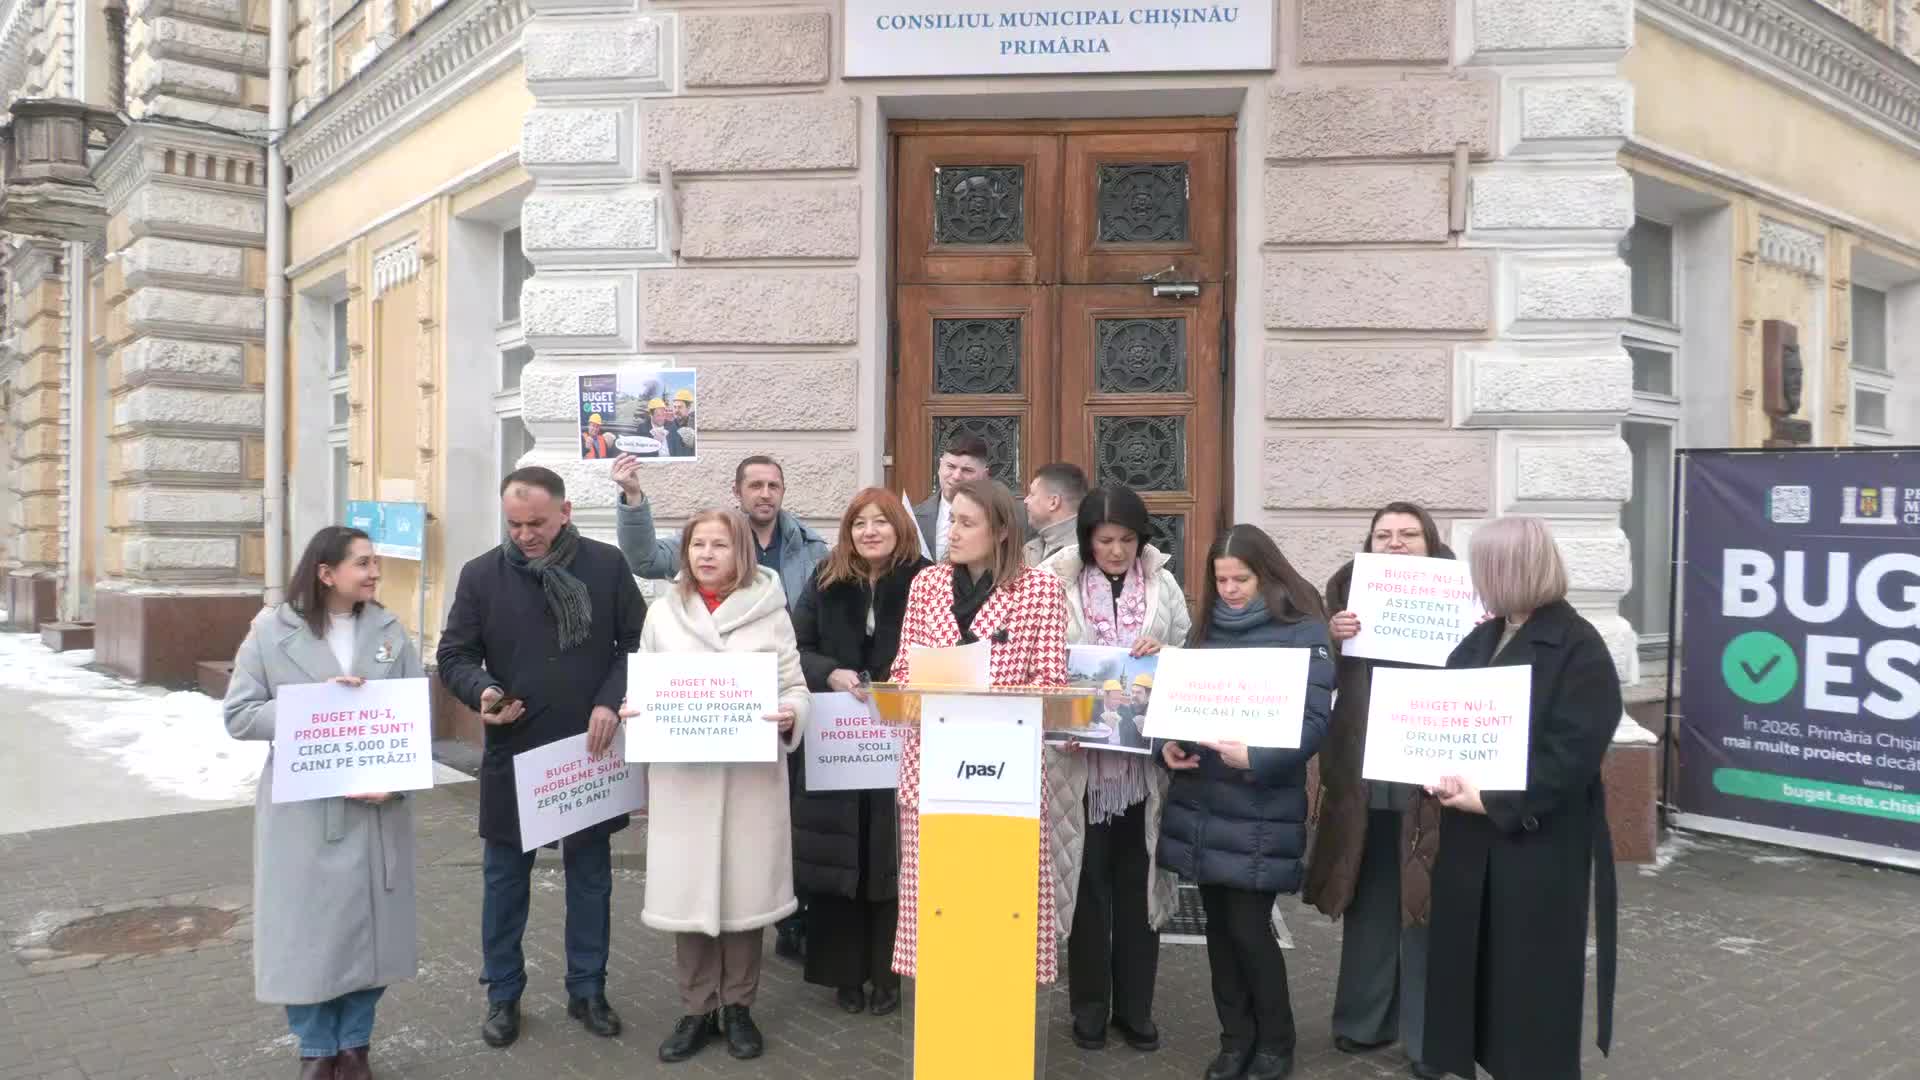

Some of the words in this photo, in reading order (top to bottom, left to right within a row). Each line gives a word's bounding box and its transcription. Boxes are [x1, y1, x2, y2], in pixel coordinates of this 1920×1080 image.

[876, 13, 994, 30] CONSILIUL
[999, 9, 1124, 28] MUNICIPAL
[1128, 7, 1239, 31] CHIȘINĂU
[1000, 37, 1111, 55] PRIMĂRIA
[582, 392, 613, 402] BUGET
[591, 402, 614, 412] ESTE
[1385, 569, 1426, 581] BUGET
[1368, 582, 1437, 596] PROBLEME
[1722, 548, 1920, 629] BUG
[1382, 612, 1460, 628] PERSONALI
[670, 678, 706, 687] BUGET
[656, 690, 719, 699] PROBLEME
[719, 690, 753, 699] SUNT!
[646, 703, 685, 711] GRUPE
[688, 702, 702, 711] CU
[706, 702, 762, 711] PROGRAM
[1410, 700, 1458, 711] BUGET
[311, 711, 355, 724] BUGET
[359, 708, 396, 721] NU-I,
[655, 714, 720, 723] PRELUNGIT
[723, 713, 753, 723] FĂRĂ
[1475, 715, 1513, 727] SUNT!
[295, 725, 366, 741] PROBLEME
[370, 722, 414, 735] SUNT!
[821, 729, 887, 740] PROBLEME
[1406, 731, 1477, 743] DRUMURI
[1482, 733, 1498, 743] CU
[1743, 715, 1757, 731] În
[1807, 724, 1872, 745] Primăria
[298, 744, 341, 756] CIRCA
[345, 740, 385, 752] 5.000
[390, 738, 409, 749] DE
[1403, 747, 1453, 760] GROPI
[1459, 749, 1499, 760] SUNT!
[1723, 735, 1751, 749] mai
[1754, 740, 1800, 756] multe
[1803, 747, 1873, 765] proiecte
[336, 757, 354, 768] PE
[358, 752, 417, 767] STRĂZI!
[545, 760, 582, 778] BUGET
[957, 760, 1005, 779] /pas/
[533, 768, 594, 797] PROBLEME
[537, 791, 567, 809] ZERO
[608, 770, 630, 785] NOI
[576, 798, 583, 808] 6
[586, 789, 610, 805] ANI!
